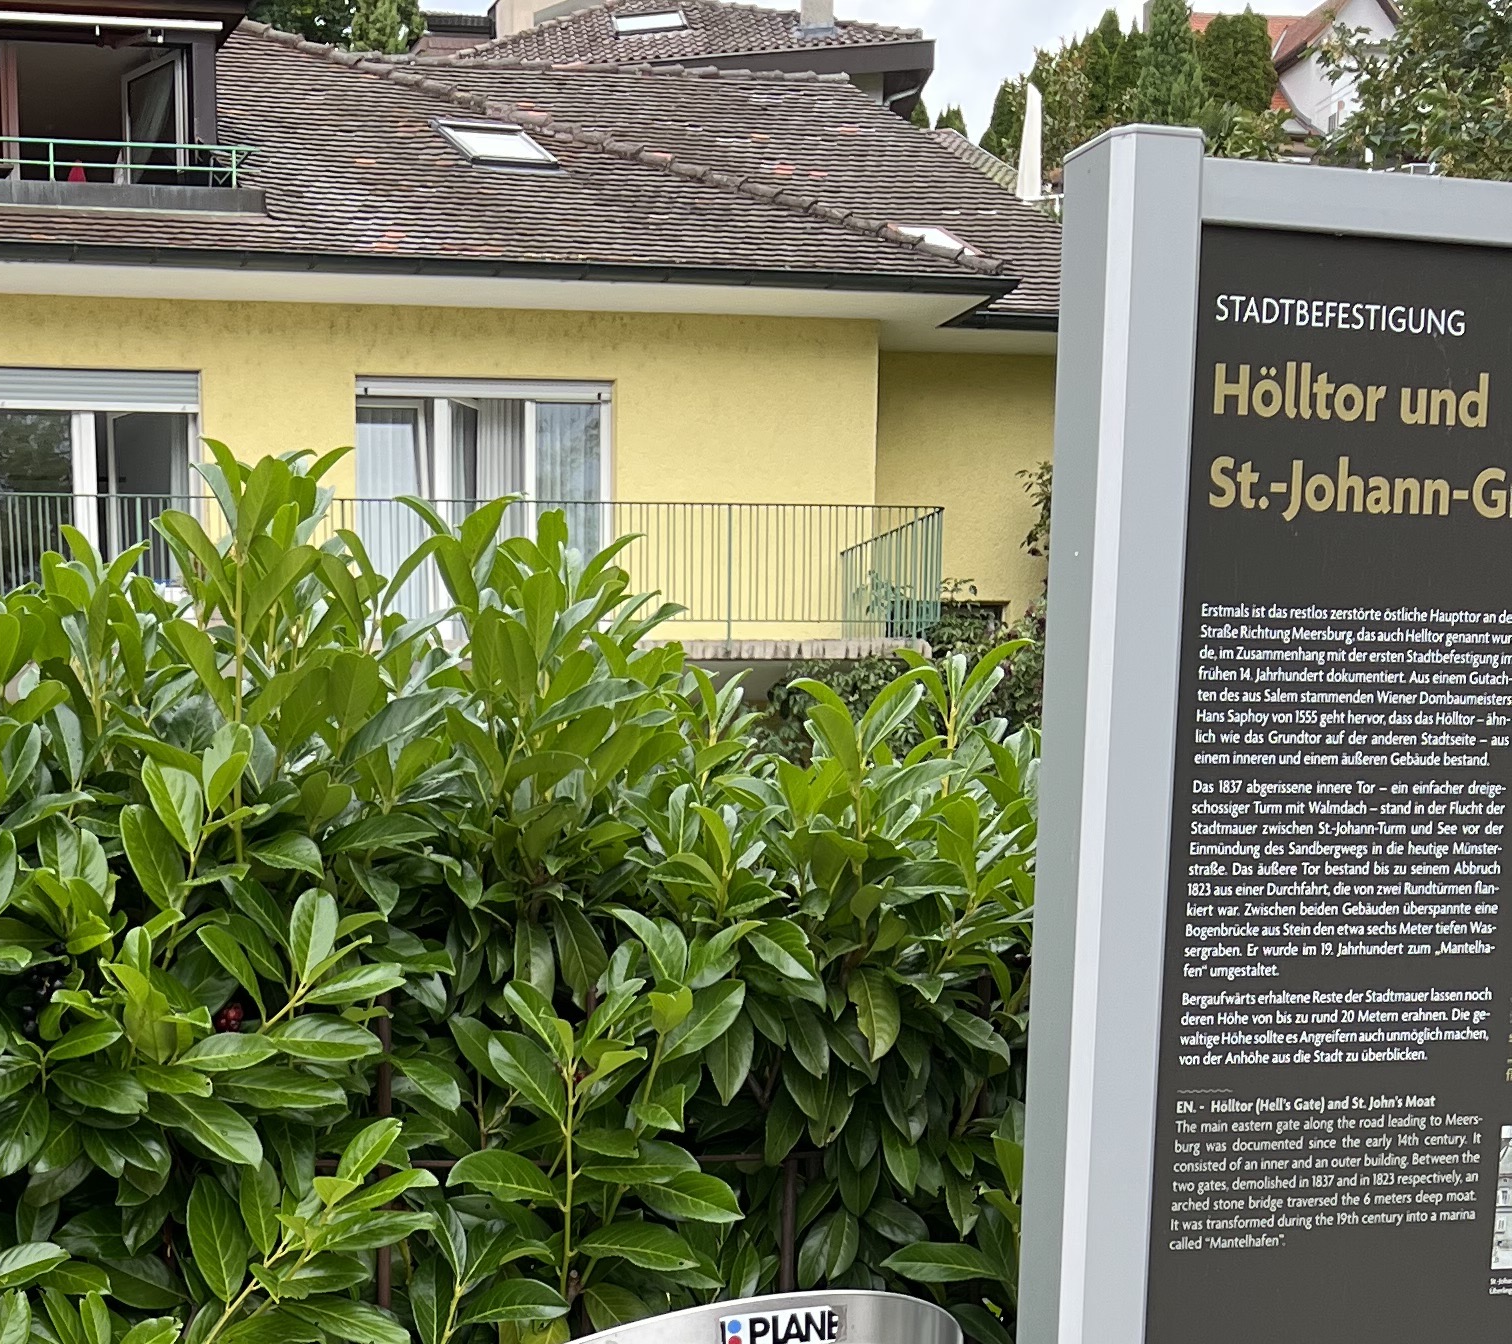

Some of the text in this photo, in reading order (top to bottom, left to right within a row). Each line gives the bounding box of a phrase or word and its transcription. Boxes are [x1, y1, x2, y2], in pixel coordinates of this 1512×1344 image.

[1215, 294, 1466, 336] STADTBEFESTIGUNG
[1213, 361, 1489, 428] Hölltor und
[1209, 455, 1512, 522] St.-Johann-G
[1201, 602, 1249, 618] Erstmals
[1251, 605, 1266, 618] ist
[1267, 603, 1287, 618] das
[1289, 604, 1328, 619] restlos
[1329, 607, 1382, 621] zerstörte
[1383, 606, 1428, 622] östliche
[1429, 608, 1481, 626] Haupttor
[1483, 613, 1496, 623] an
[1198, 665, 1237, 681] frühen
[1254, 666, 1324, 683] Jahrhundert
[1408, 670, 1430, 684] Aus
[1432, 670, 1466, 684] einem
[1197, 687, 1512, 705] ten des aus Salem stammenden Wiener Dombaumeisters
[1196, 708, 1511, 728] Hans Saphoy von 1555 geht hervor, dass das Hölltor ähn-
[1194, 750, 1490, 766] einem inneren und einem äußeren Gebäude bestand.
[1192, 778, 1506, 798] Das 1837 abgerissene innere Tor ein einfacher dreige-
[1190, 820, 1504, 836] Stadtmauer zwischen St.-Johann-Turm und See vor der
[1189, 840, 1502, 859] Einmündung des Sandbergwegs in die heutige Münster-
[1188, 860, 1501, 875] straße. Das äußere Tor bestand bis zu seinem Abbruch
[1186, 900, 1498, 918] kiert war. Zwischen beiden Gebäuden überspannte eine
[1184, 942, 1242, 960] sergraben.
[1246, 943, 1259, 956] Er
[1262, 942, 1298, 956] wurde
[1302, 942, 1317, 955] im
[1336, 940, 1404, 957] Jahrhundert
[1407, 944, 1431, 954] zum
[1182, 986, 1492, 1009] Bergaufwärts erhaltene Reste der Stadtmauer lassen noch
[1179, 1046, 1428, 1065] von der Anhöhe aus die Stadt zu überblicken.
[1176, 1100, 1196, 1113] EN.
[1210, 1098, 1253, 1113] Hölltor
[1293, 1096, 1325, 1113] Gate)
[1327, 1095, 1350, 1110] and
[1351, 1096, 1367, 1109] St.
[1405, 1095, 1436, 1107] Moat
[1175, 1113, 1483, 1134] The main eastern gate along the road leading to Meers-
